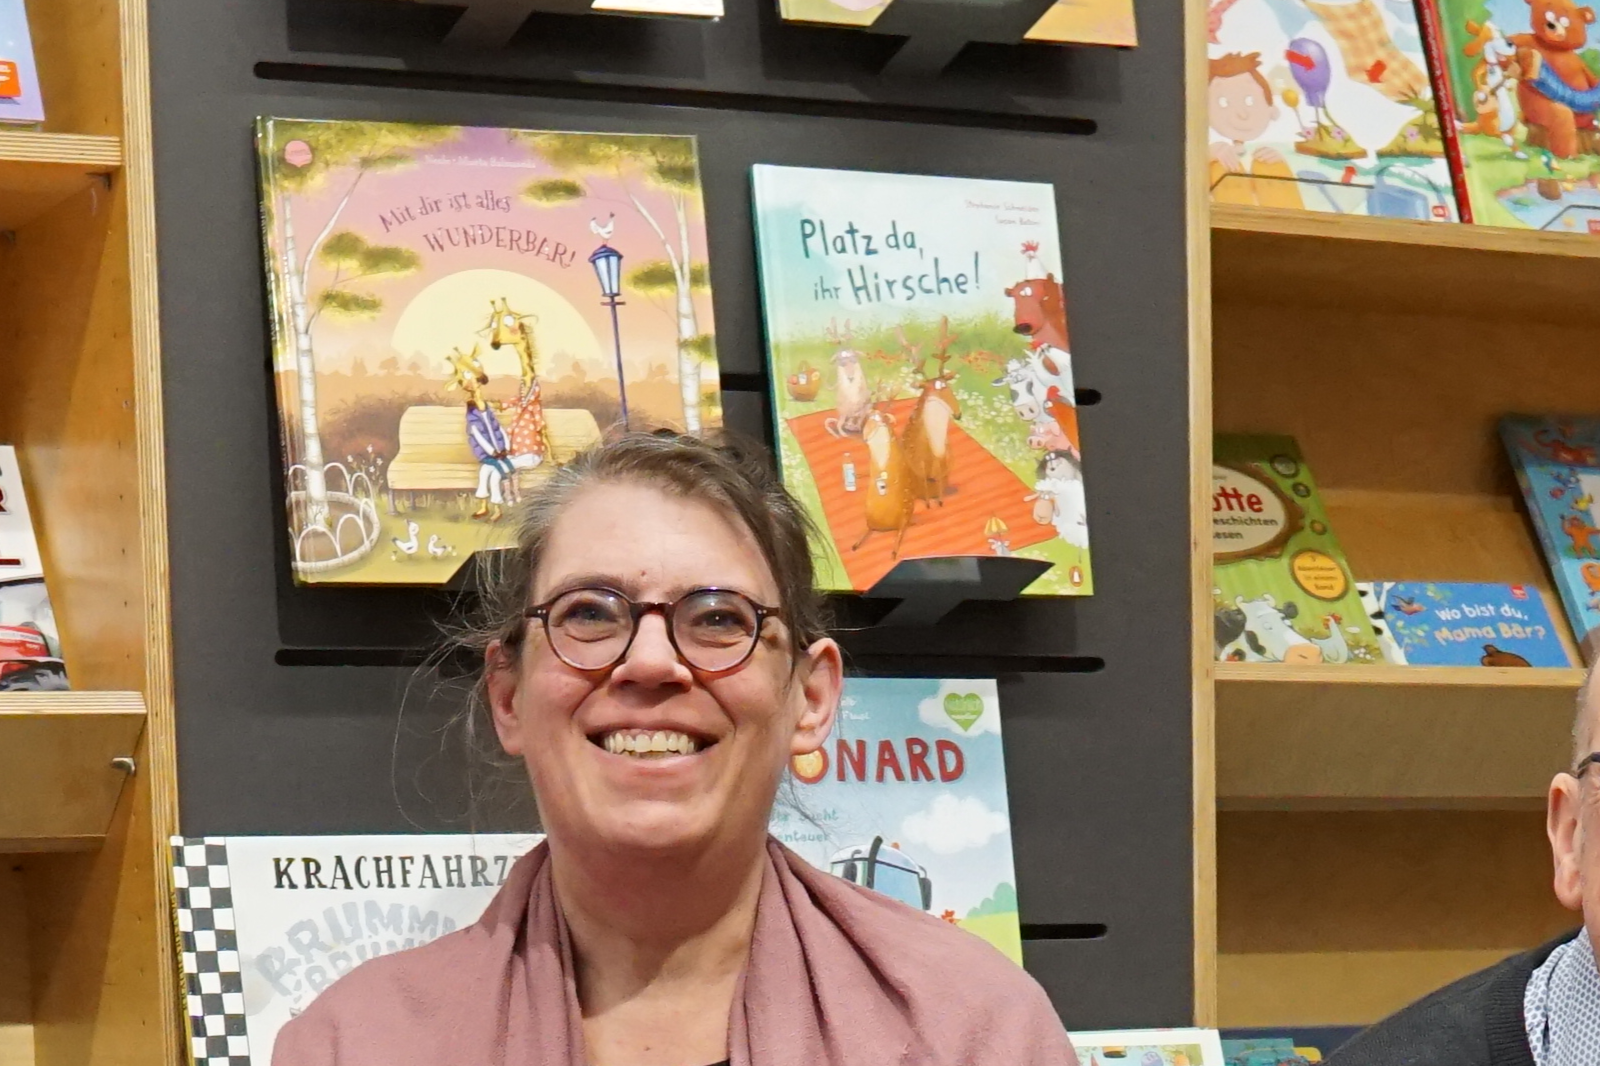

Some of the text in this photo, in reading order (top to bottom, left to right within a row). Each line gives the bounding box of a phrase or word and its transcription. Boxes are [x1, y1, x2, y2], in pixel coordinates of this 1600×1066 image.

[379, 190, 513, 234] Mit dir ist alles
[423, 224, 578, 269] WUNDERBAR!
[800, 218, 924, 260] Platz da,
[814, 251, 981, 305] ihr Hirsche!
[1212, 515, 1279, 527] eschichten
[1434, 607, 1462, 621] Wo
[1462, 603, 1496, 618] bist
[1433, 621, 1546, 646] Mama Bär?
[790, 737, 965, 784] ONARD
[776, 830, 828, 842] enteuer
[272, 854, 524, 890] KRACHFAHRZ
